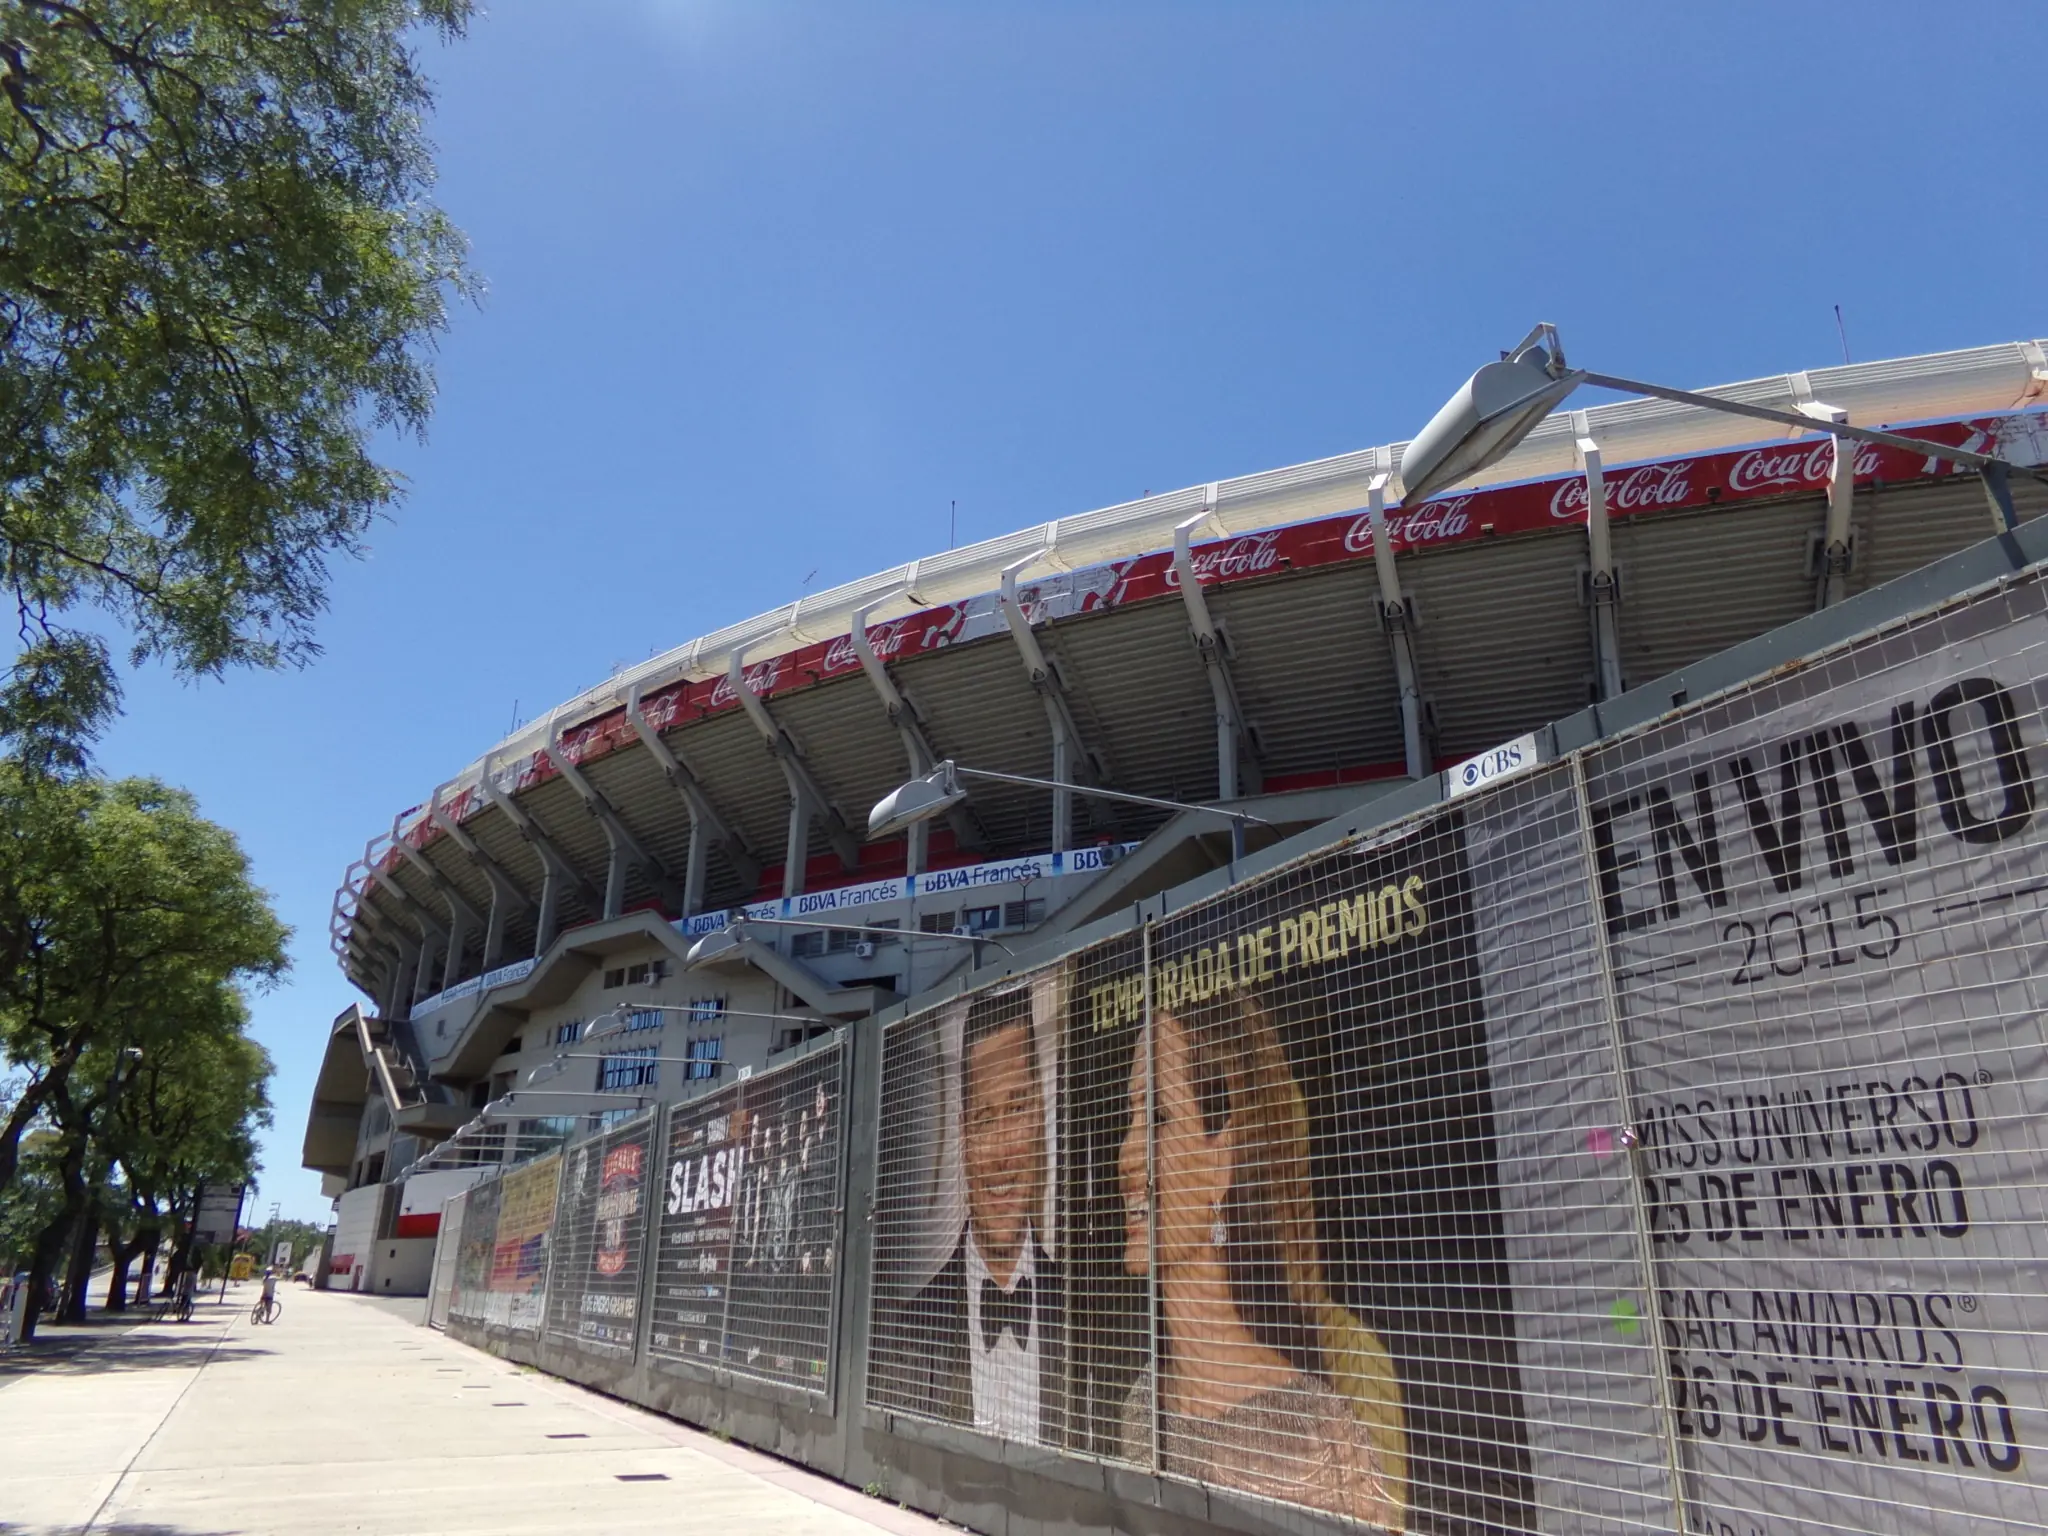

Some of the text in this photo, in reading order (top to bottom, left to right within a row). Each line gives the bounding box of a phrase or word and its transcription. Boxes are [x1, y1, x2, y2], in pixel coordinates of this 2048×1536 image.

[1728, 439, 1883, 491] Coca-Cla
[1344, 495, 1474, 552] Coa-Cola
[1165, 530, 1283, 587] Cca-Cola
[823, 619, 908, 671] CocCola
[1481, 744, 1522, 778] CBS
[972, 858, 1041, 885] Francés
[1074, 849, 1113, 871] BBV
[694, 913, 724, 933] BBVA
[799, 881, 898, 914] BBVA Francés
[1088, 875, 1429, 1034] TEMPORADA DE PREMIOS
[1723, 888, 1900, 986] 2015
[1635, 1100, 1722, 1169] MISS
[667, 1146, 745, 1215] SLASH
[1698, 1172, 1764, 1241] DE
[1771, 1160, 1970, 1240] ENERO
[1670, 1364, 2022, 1473] 26 DE ENERO
